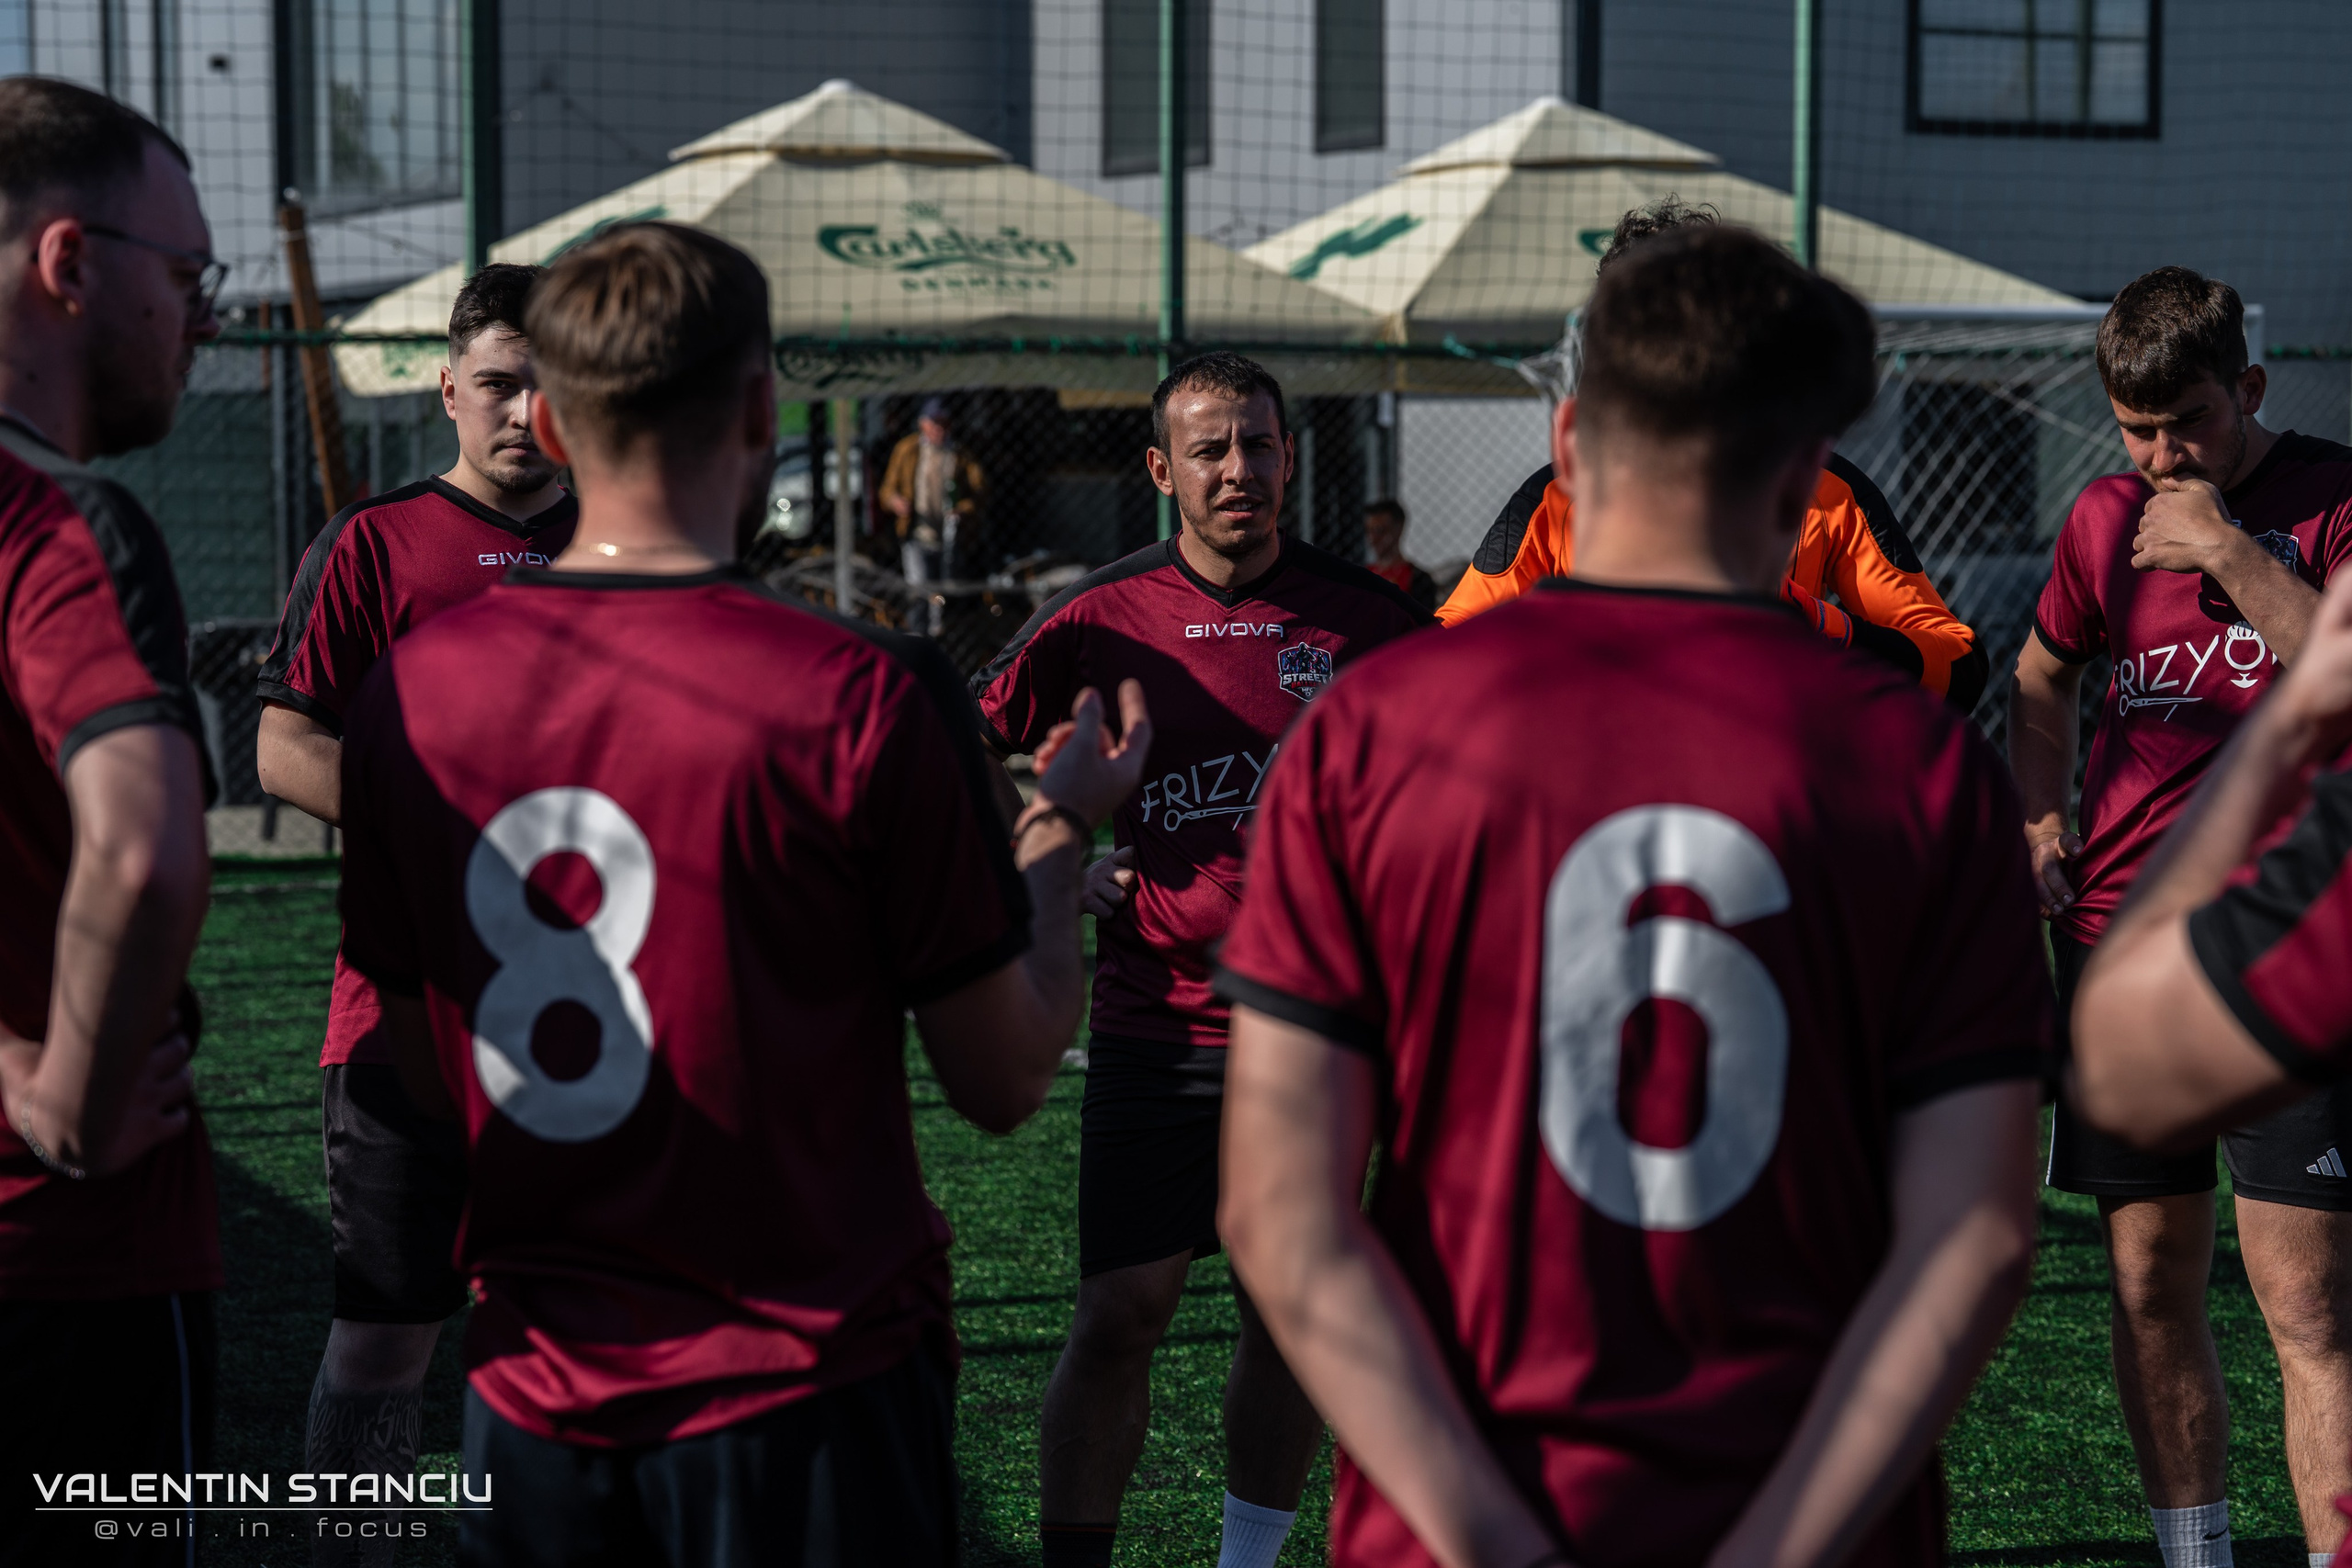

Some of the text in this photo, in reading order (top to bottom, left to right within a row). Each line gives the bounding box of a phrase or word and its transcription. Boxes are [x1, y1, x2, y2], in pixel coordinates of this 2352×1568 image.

[817, 223, 1077, 272] Carlsberg
[478, 552, 559, 566] GIVOV
[1185, 622, 1284, 638] GIVOVA
[1283, 672, 1328, 686] STREET
[2114, 626, 2278, 704] RIZYO
[1141, 743, 1279, 824] FRIZY
[465, 785, 657, 1143] 8
[1539, 803, 1792, 1232] 6
